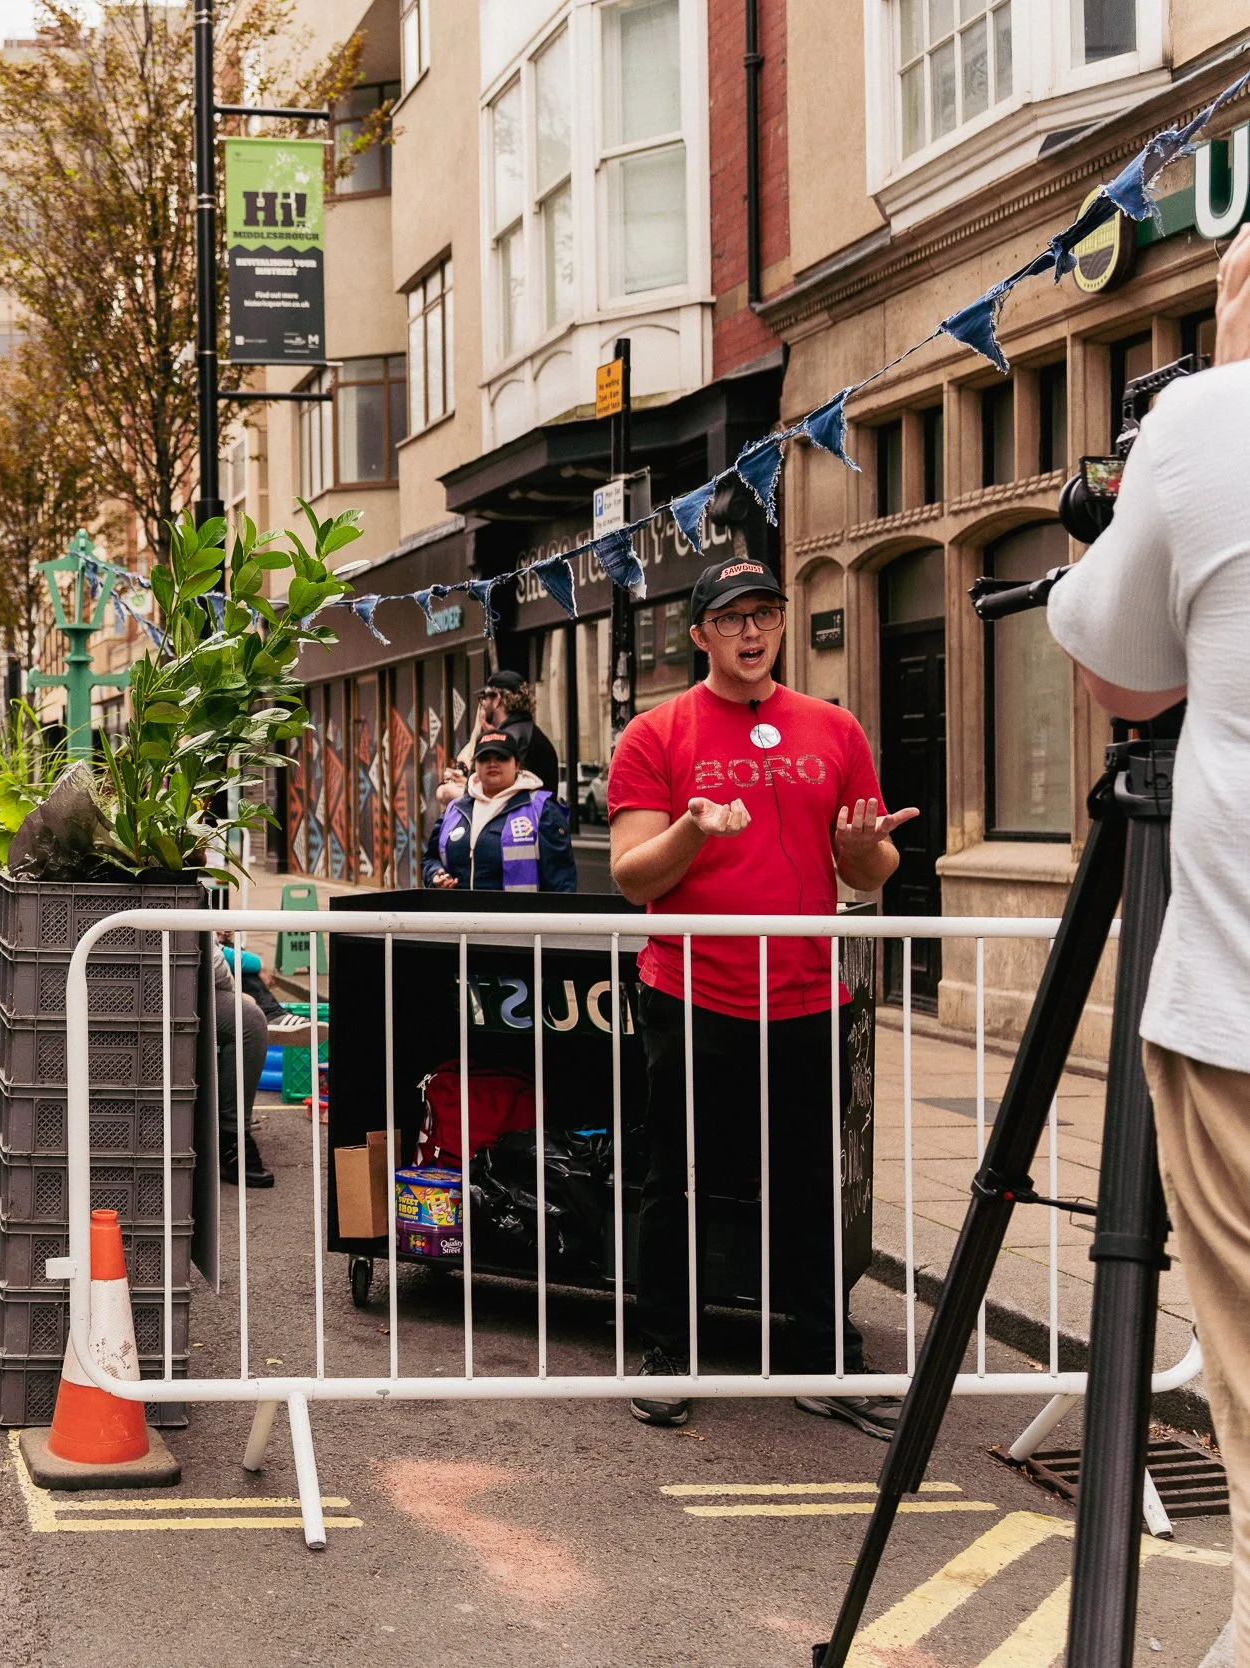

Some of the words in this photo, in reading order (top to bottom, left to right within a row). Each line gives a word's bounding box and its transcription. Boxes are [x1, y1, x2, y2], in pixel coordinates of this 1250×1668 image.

[243, 191, 307, 228] Hi!
[233, 231, 320, 241] MIDDLESBROUGH
[724, 564, 761, 576] SAWDUST
[694, 753, 827, 790] BORO
[441, 1240, 463, 1249] Quality
[442, 1246, 461, 1254] Street
